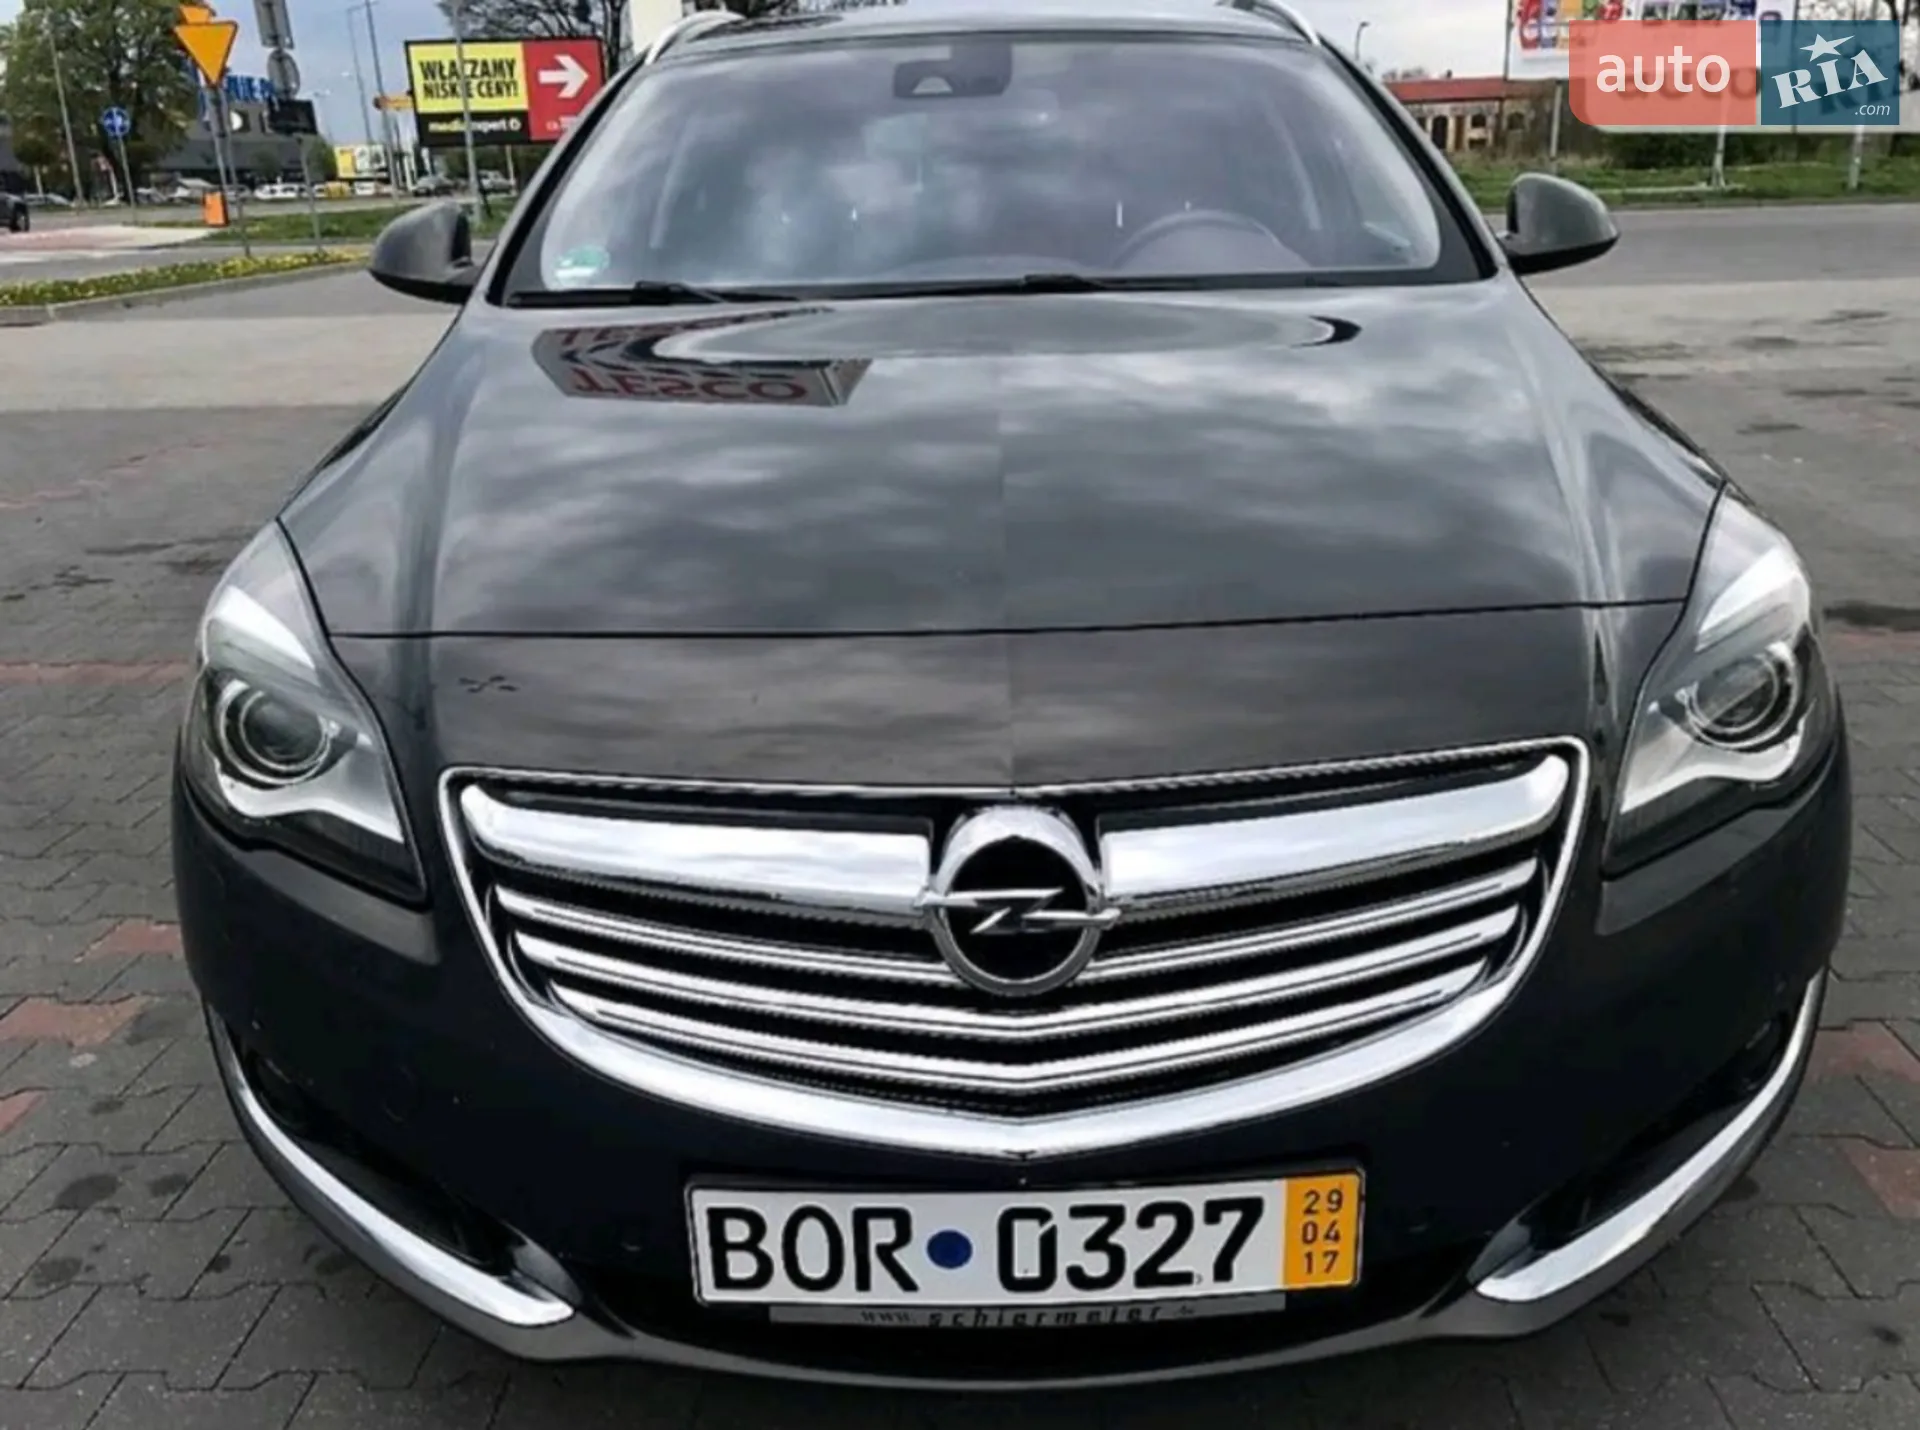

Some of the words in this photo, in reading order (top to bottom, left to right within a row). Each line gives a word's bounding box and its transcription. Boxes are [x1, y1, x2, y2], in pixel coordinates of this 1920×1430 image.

[423, 80, 474, 99] NISKE
[1303, 1189, 1344, 1214] 29
[706, 1205, 919, 1293] BOR
[997, 1196, 1265, 1293] 0327
[1302, 1220, 1341, 1245] 04
[1303, 1251, 1339, 1275] 17
